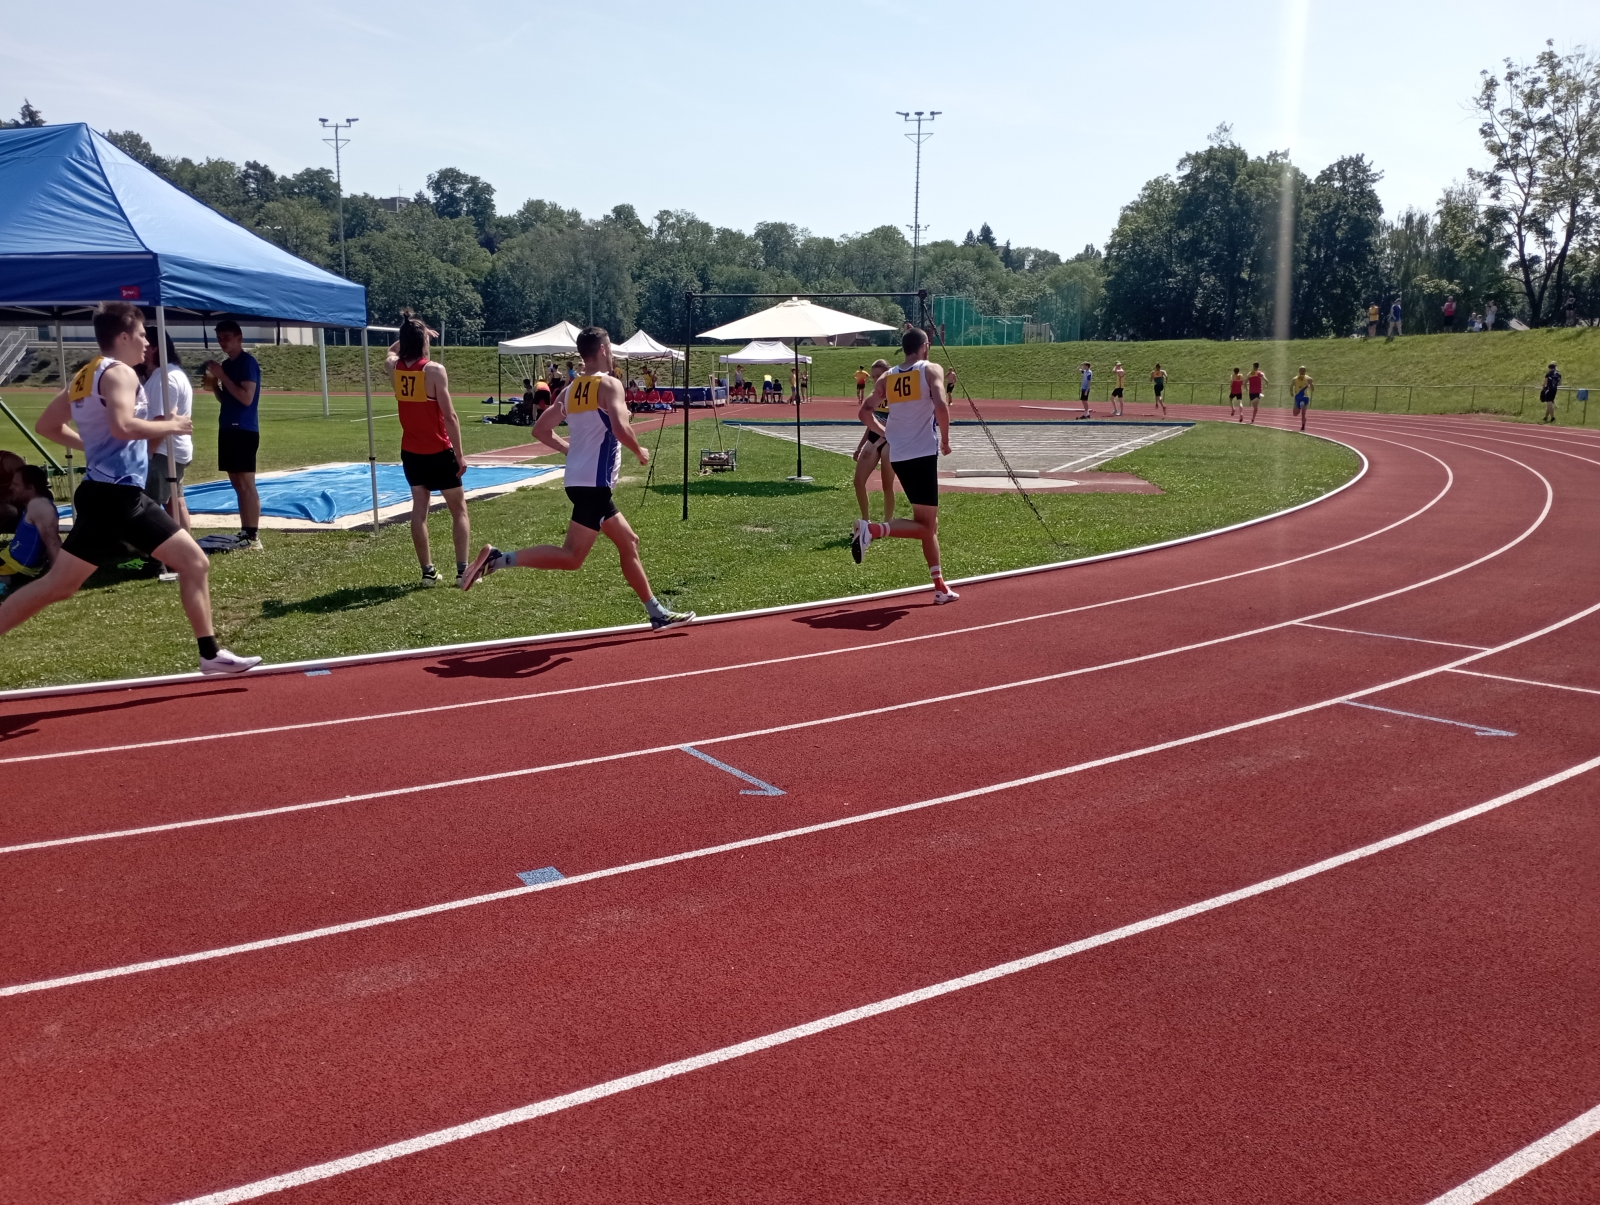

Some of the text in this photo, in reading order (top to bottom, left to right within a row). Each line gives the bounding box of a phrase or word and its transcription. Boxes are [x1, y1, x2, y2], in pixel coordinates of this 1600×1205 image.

[401, 375, 416, 397] 37
[574, 381, 591, 406] 44
[893, 376, 911, 398] 46
